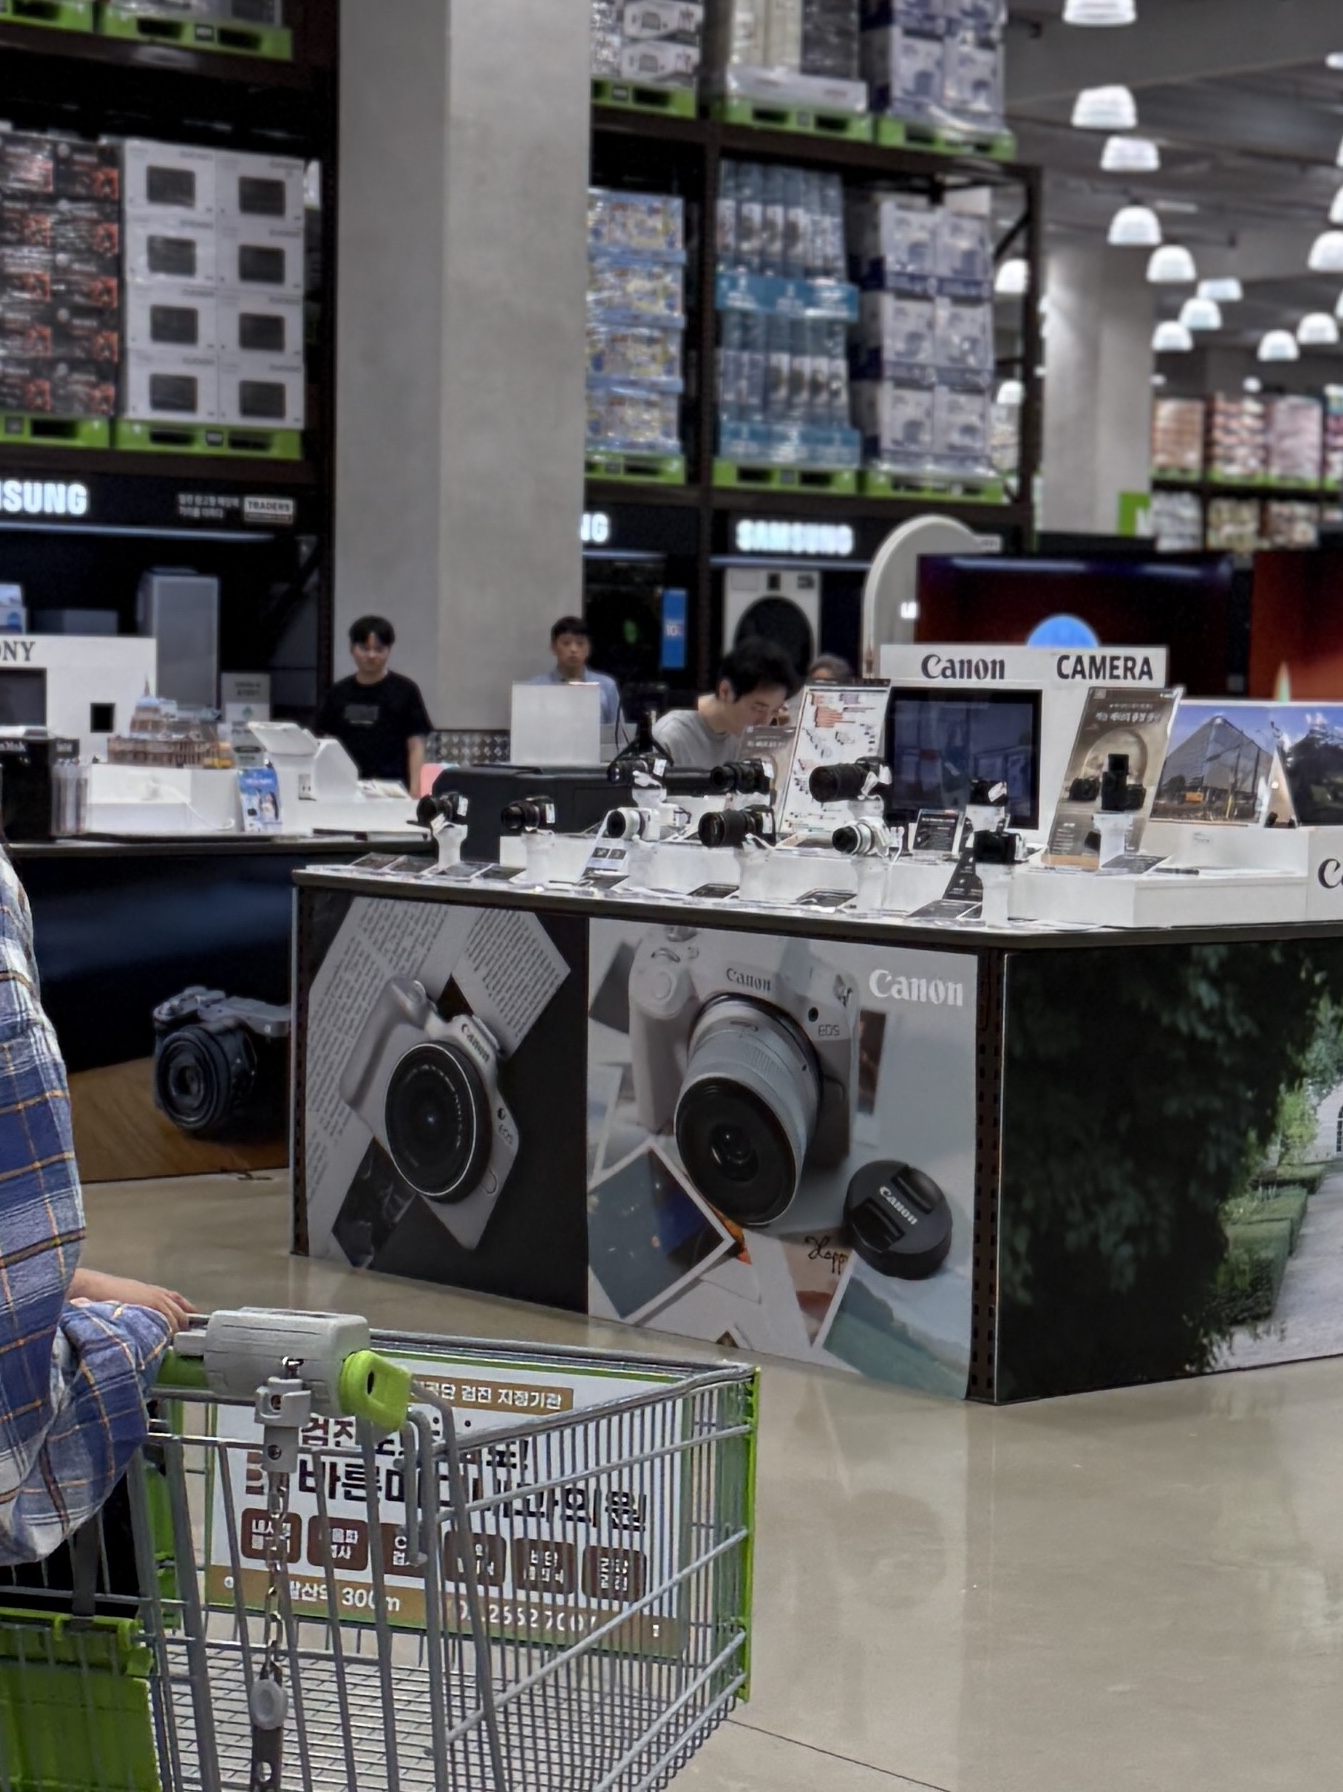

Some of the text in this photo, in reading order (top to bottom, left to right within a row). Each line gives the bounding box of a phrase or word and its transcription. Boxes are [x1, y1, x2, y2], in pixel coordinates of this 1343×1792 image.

[921, 653, 1154, 681] Canon CAMERA
[1318, 858, 1343, 889] C
[726, 967, 771, 992] Canon
[868, 968, 964, 1007] Canon
[461, 1023, 490, 1064] Canon
[818, 1024, 840, 1037] EOS
[879, 1185, 918, 1225] Canon
[461, 1384, 492, 1404] 검진
